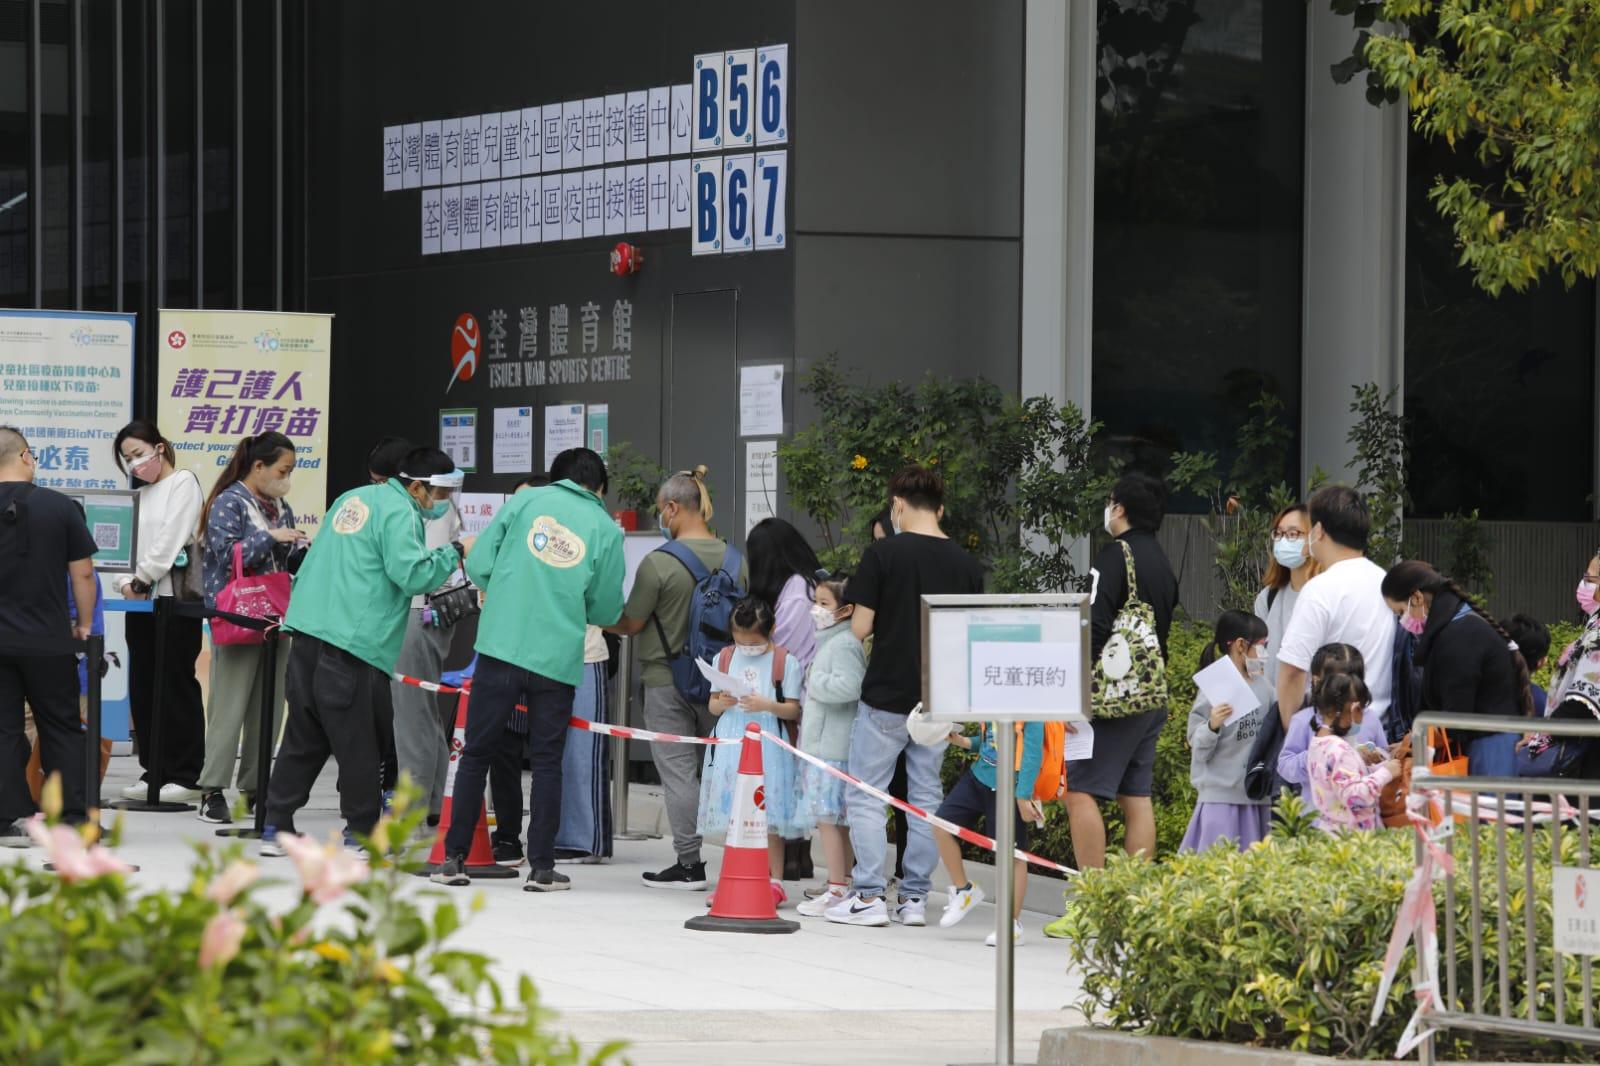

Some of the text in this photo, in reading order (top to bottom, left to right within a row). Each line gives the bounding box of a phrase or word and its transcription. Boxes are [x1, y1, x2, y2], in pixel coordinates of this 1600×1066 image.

[385, 60, 782, 177] 荃灣體育館兒童社區疫苗接種中心 B56
[423, 166, 780, 243] 荃灣體育館社區疫苗接種中心 B67
[487, 299, 632, 360] 荃灣體育館
[170, 367, 303, 401] 護己護人
[488, 354, 632, 389] TSUEN WAN SPORTS CENTRE
[184, 404, 321, 437] 齊打疫苗
[207, 442, 240, 452] yours
[983, 665, 1067, 688] 兒童預約
[1237, 730, 1258, 741] BOO
